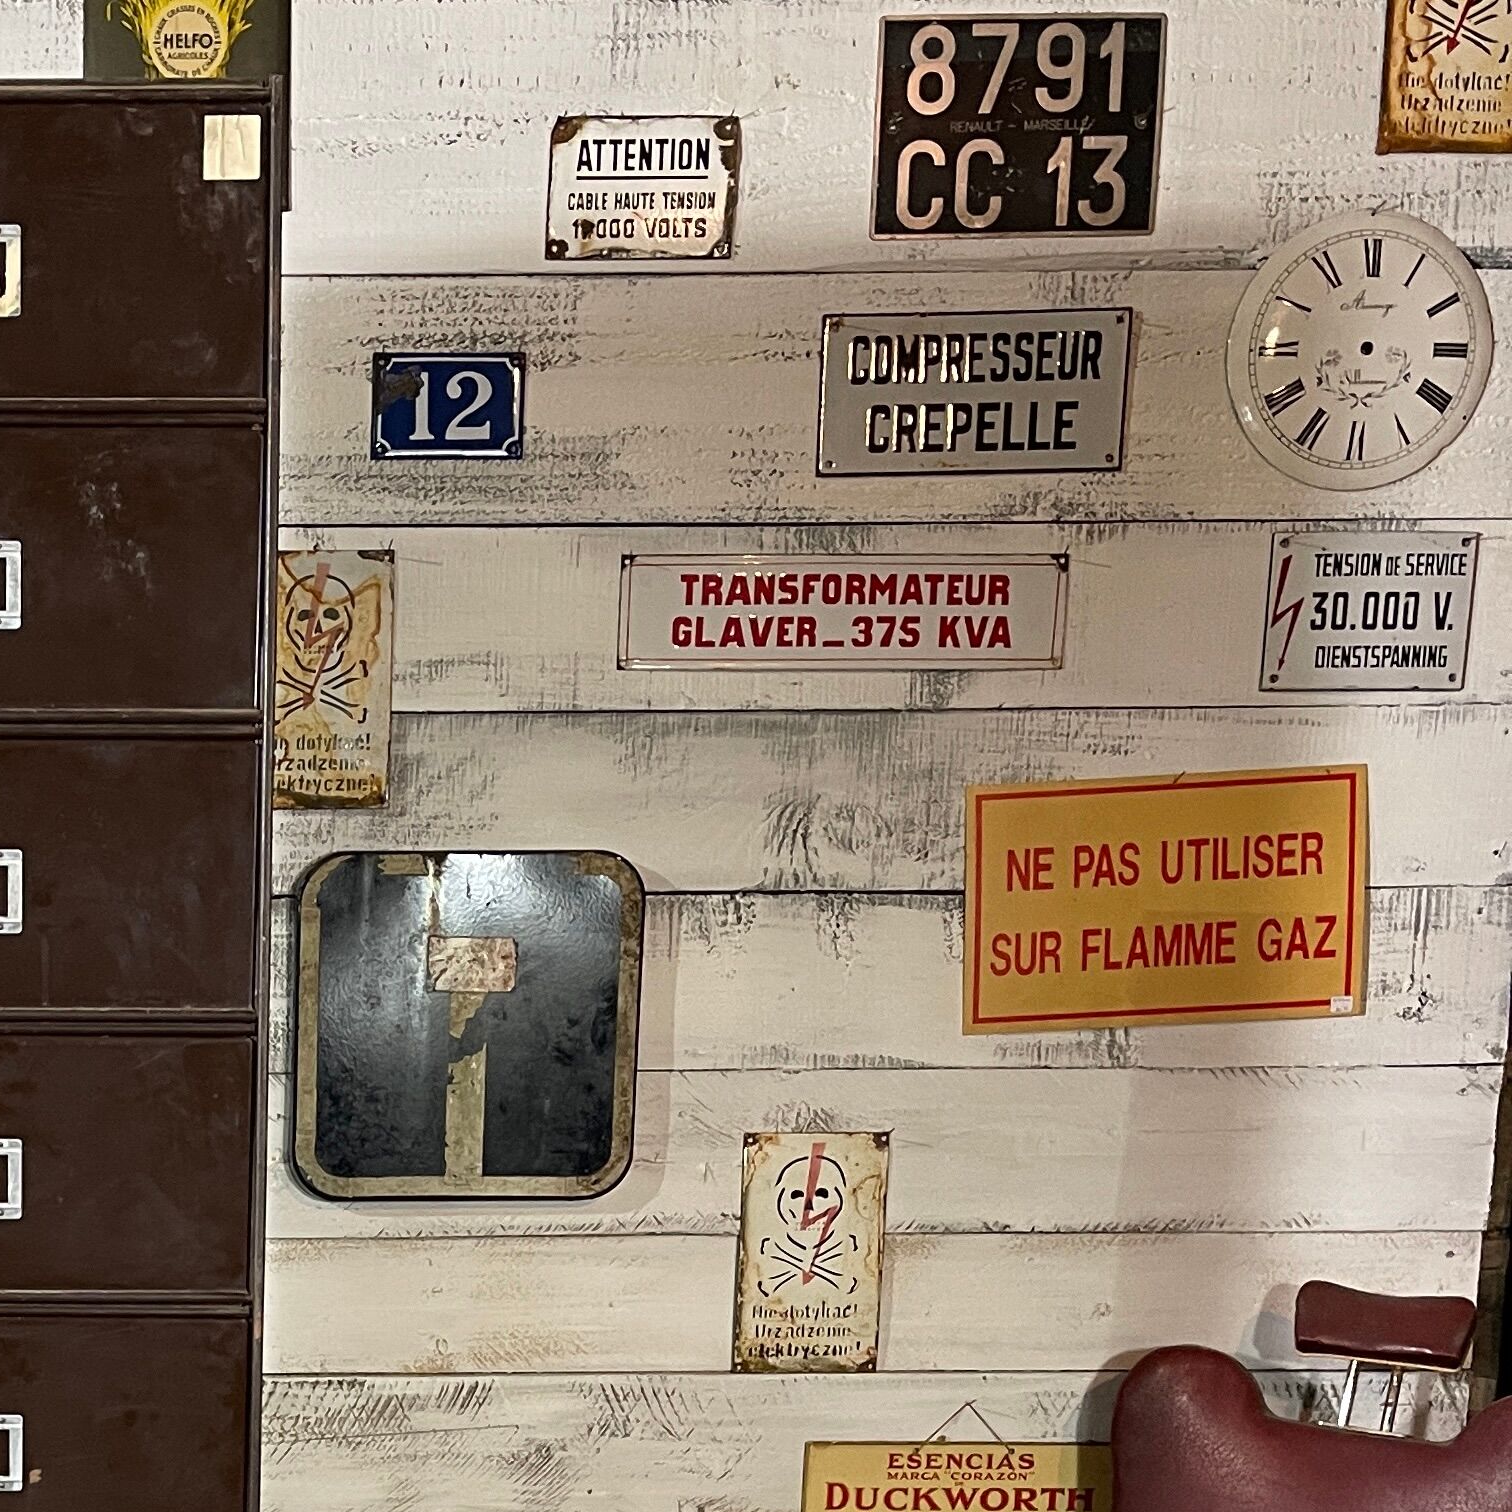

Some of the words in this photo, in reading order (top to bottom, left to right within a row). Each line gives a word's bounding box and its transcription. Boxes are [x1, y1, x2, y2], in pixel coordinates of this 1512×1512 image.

[163, 33, 213, 49] HELFO
[907, 21, 1126, 115] 8791
[949, 120, 1004, 133] RENAULT
[576, 138, 710, 172] ATTENTION
[896, 138, 1005, 230] CC
[1047, 135, 1128, 227] 13
[567, 192, 608, 210] CABLE
[614, 192, 655, 209] HAUTE
[662, 191, 716, 209] TENSION
[644, 217, 707, 238] VOLTS
[848, 331, 1102, 385] COMPRESSEUR
[409, 370, 493, 440] 12
[865, 401, 1079, 453] CREPELLE
[1315, 553, 1381, 577] TENSION
[1385, 556, 1400, 576] DE
[1405, 553, 1467, 576] SERVICE
[681, 573, 1010, 606] TRANSFORMATEUR
[1310, 591, 1420, 631] 30.000
[1434, 591, 1453, 631] V.
[938, 616, 1011, 648] KVA
[1314, 645, 1448, 669] DIENSTSPANNING
[1006, 847, 1054, 892] NE
[1073, 842, 1140, 888] PAS
[1161, 832, 1323, 884] UTILISER
[990, 931, 1061, 977] SUR
[1081, 920, 1236, 971] FLAMME
[1257, 915, 1337, 963] GAZ
[887, 1453, 1035, 1470] ESENCIAS
[887, 1472, 941, 1481] MARCA
